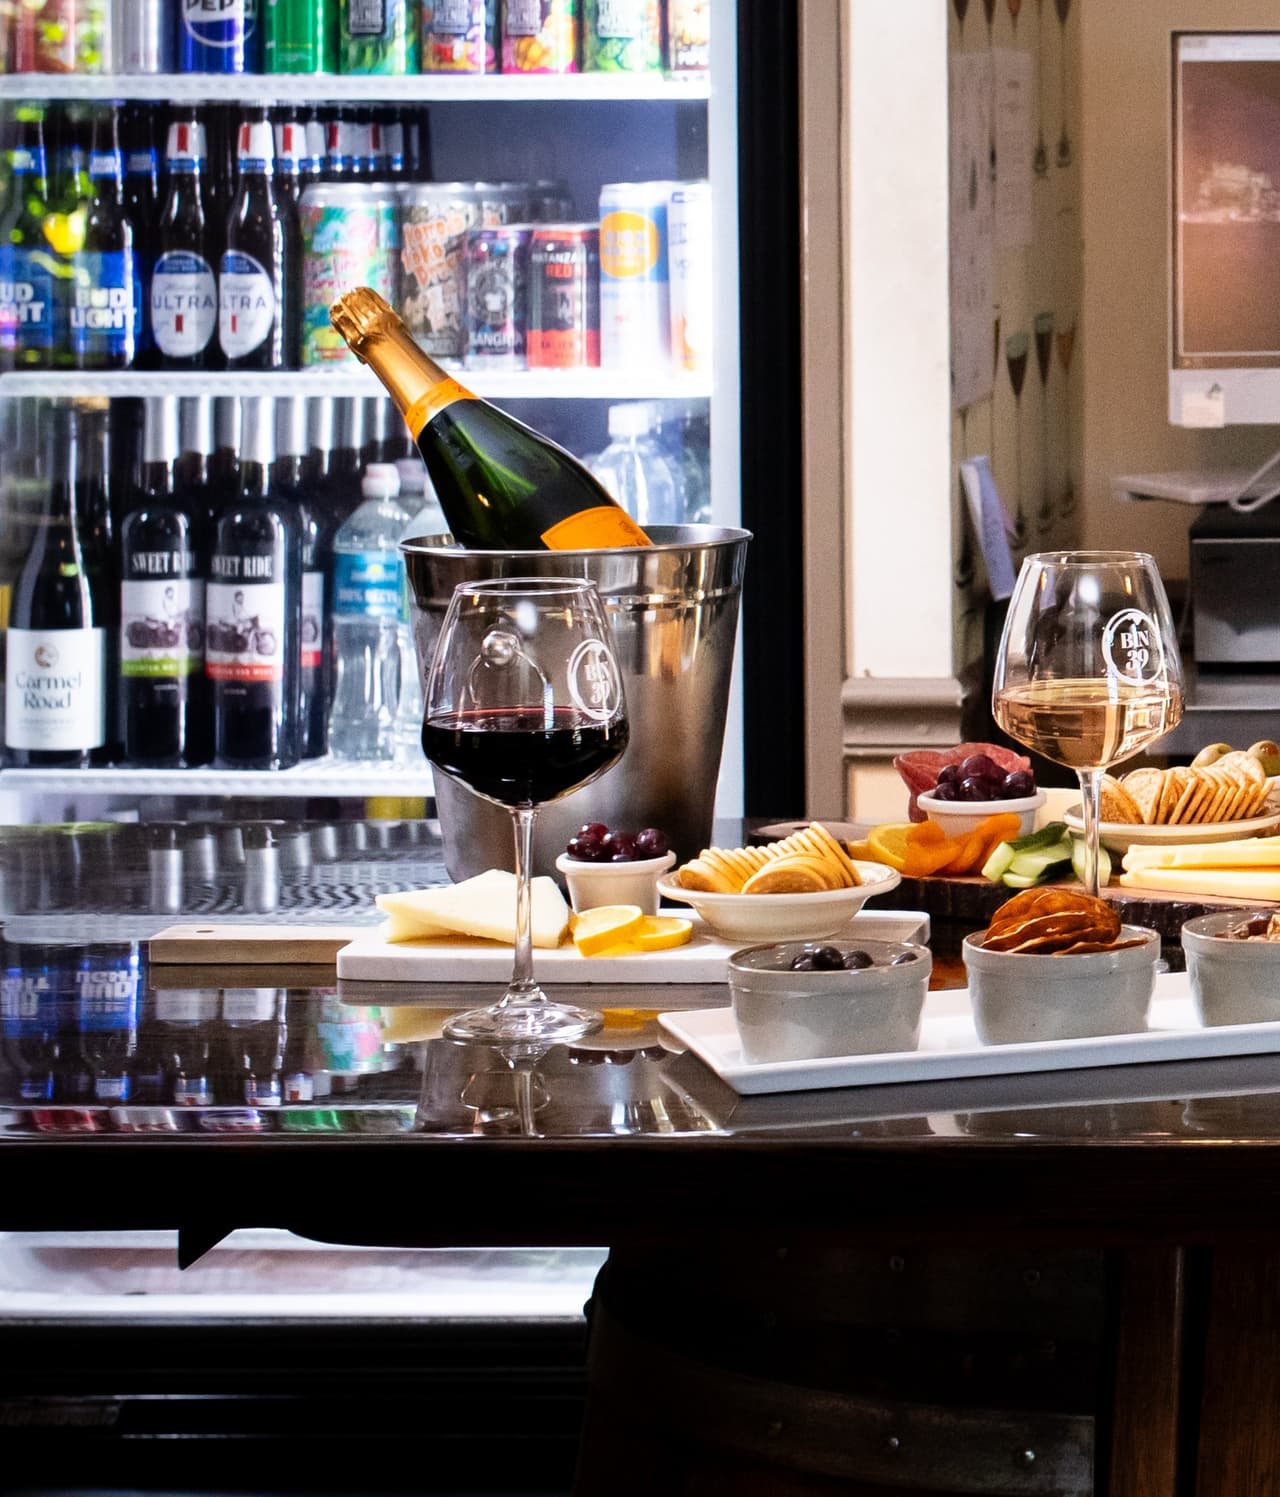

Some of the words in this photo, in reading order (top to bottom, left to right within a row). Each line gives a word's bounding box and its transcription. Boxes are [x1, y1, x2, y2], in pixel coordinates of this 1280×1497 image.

[152, 292, 215, 310] ULTRA
[221, 292, 267, 310] LTRA
[131, 551, 170, 574] SWEET
[1120, 631, 1149, 649] BIN
[1125, 648, 1149, 670] 39
[16, 672, 82, 689] Carmel
[24, 691, 71, 710] Road
